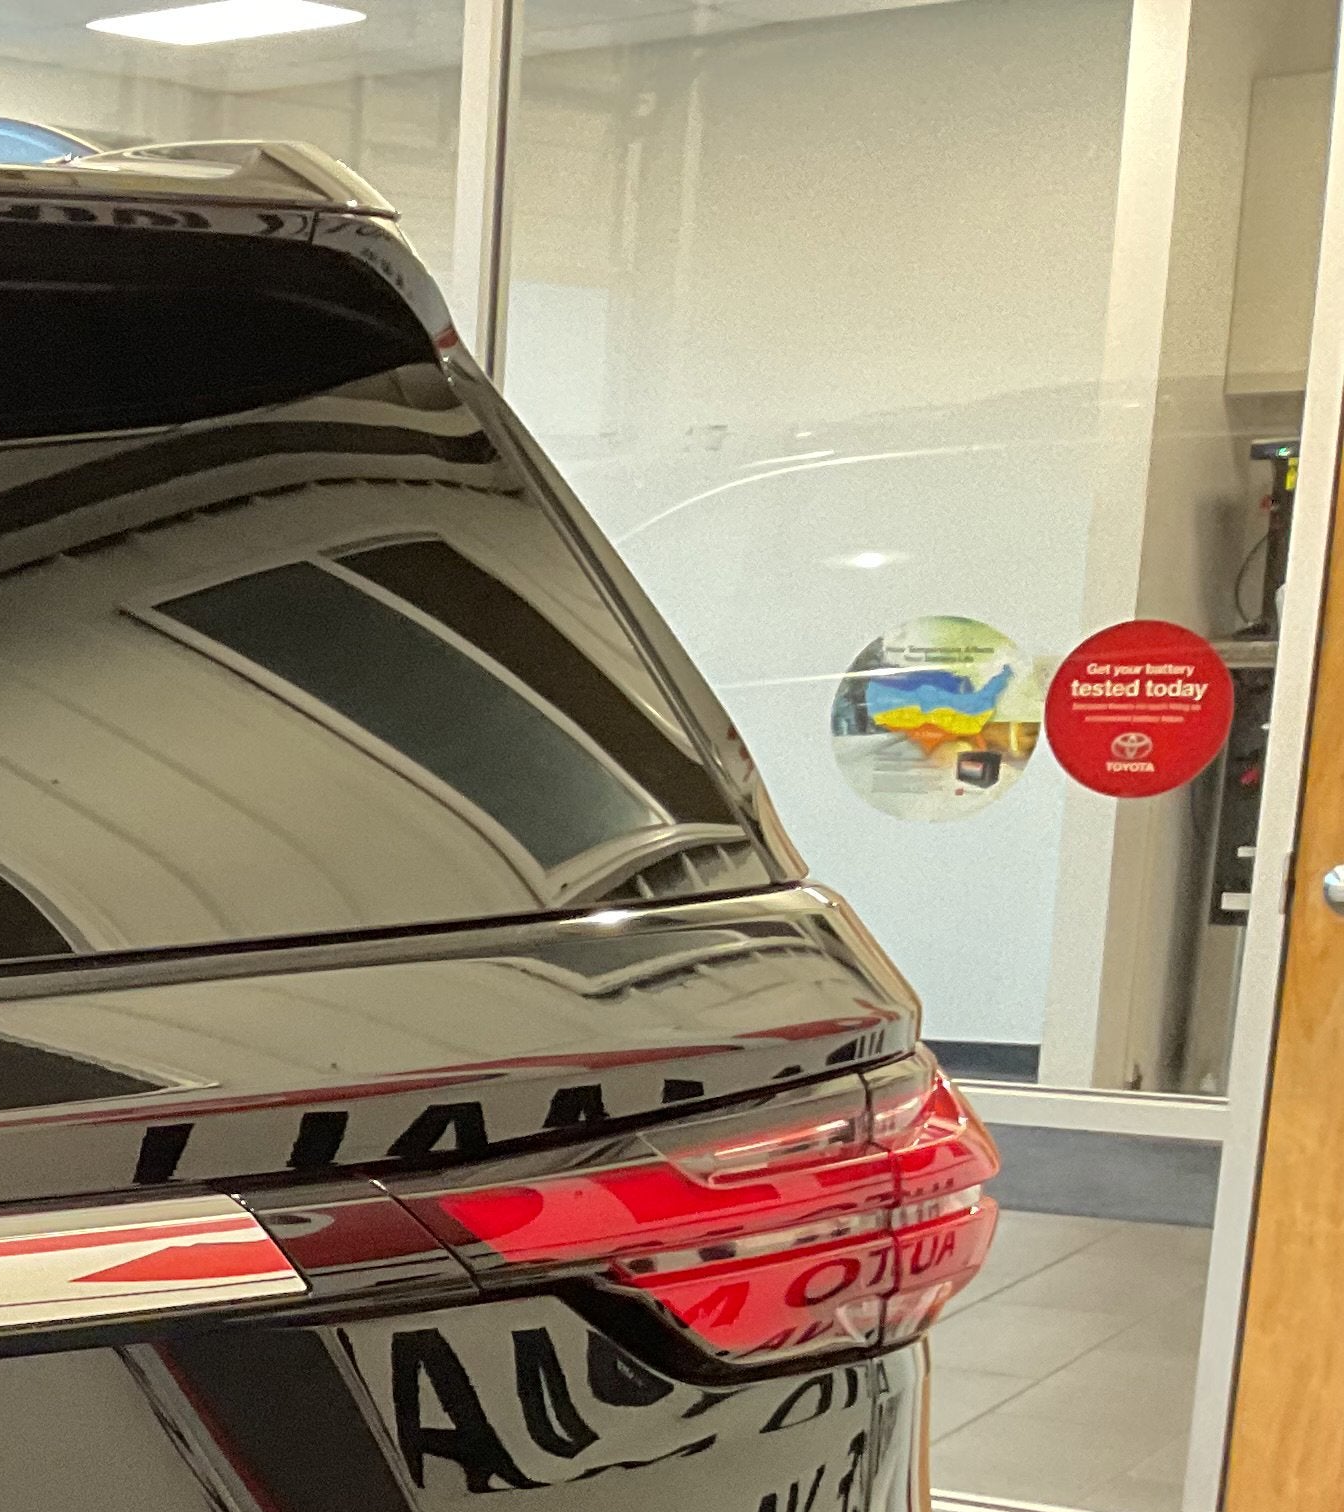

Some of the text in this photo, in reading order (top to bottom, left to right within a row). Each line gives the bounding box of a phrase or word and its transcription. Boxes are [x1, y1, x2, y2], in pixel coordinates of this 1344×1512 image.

[1086, 663, 1195, 677] Get your battery
[1071, 679, 1209, 701] tested today
[1106, 761, 1155, 772] TOYOTA
